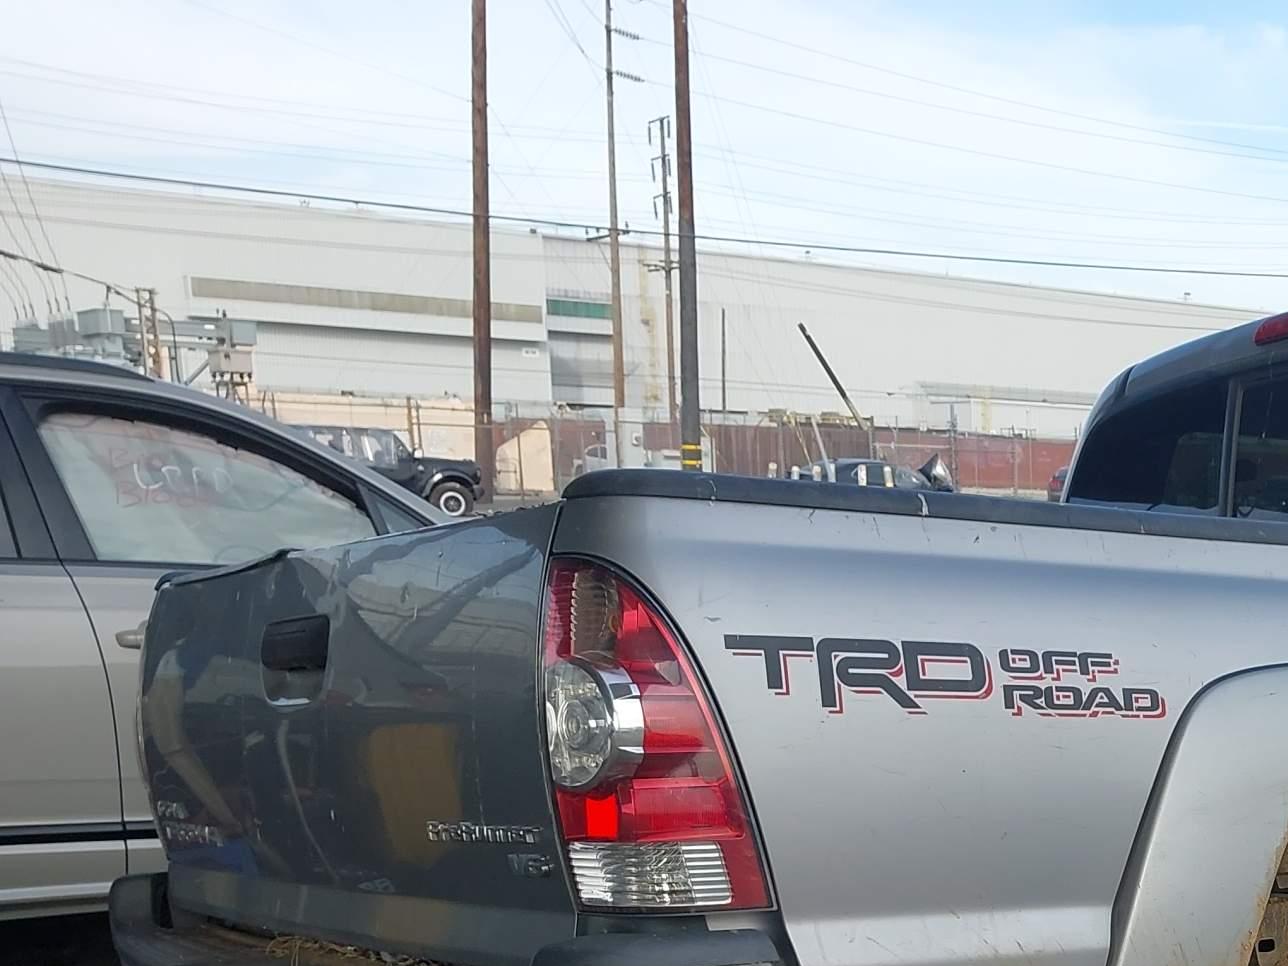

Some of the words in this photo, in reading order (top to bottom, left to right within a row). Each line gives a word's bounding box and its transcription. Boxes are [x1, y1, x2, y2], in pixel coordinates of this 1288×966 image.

[724, 634, 993, 714] TRD
[998, 648, 1119, 682] OFF
[1002, 684, 1166, 718] ROAD
